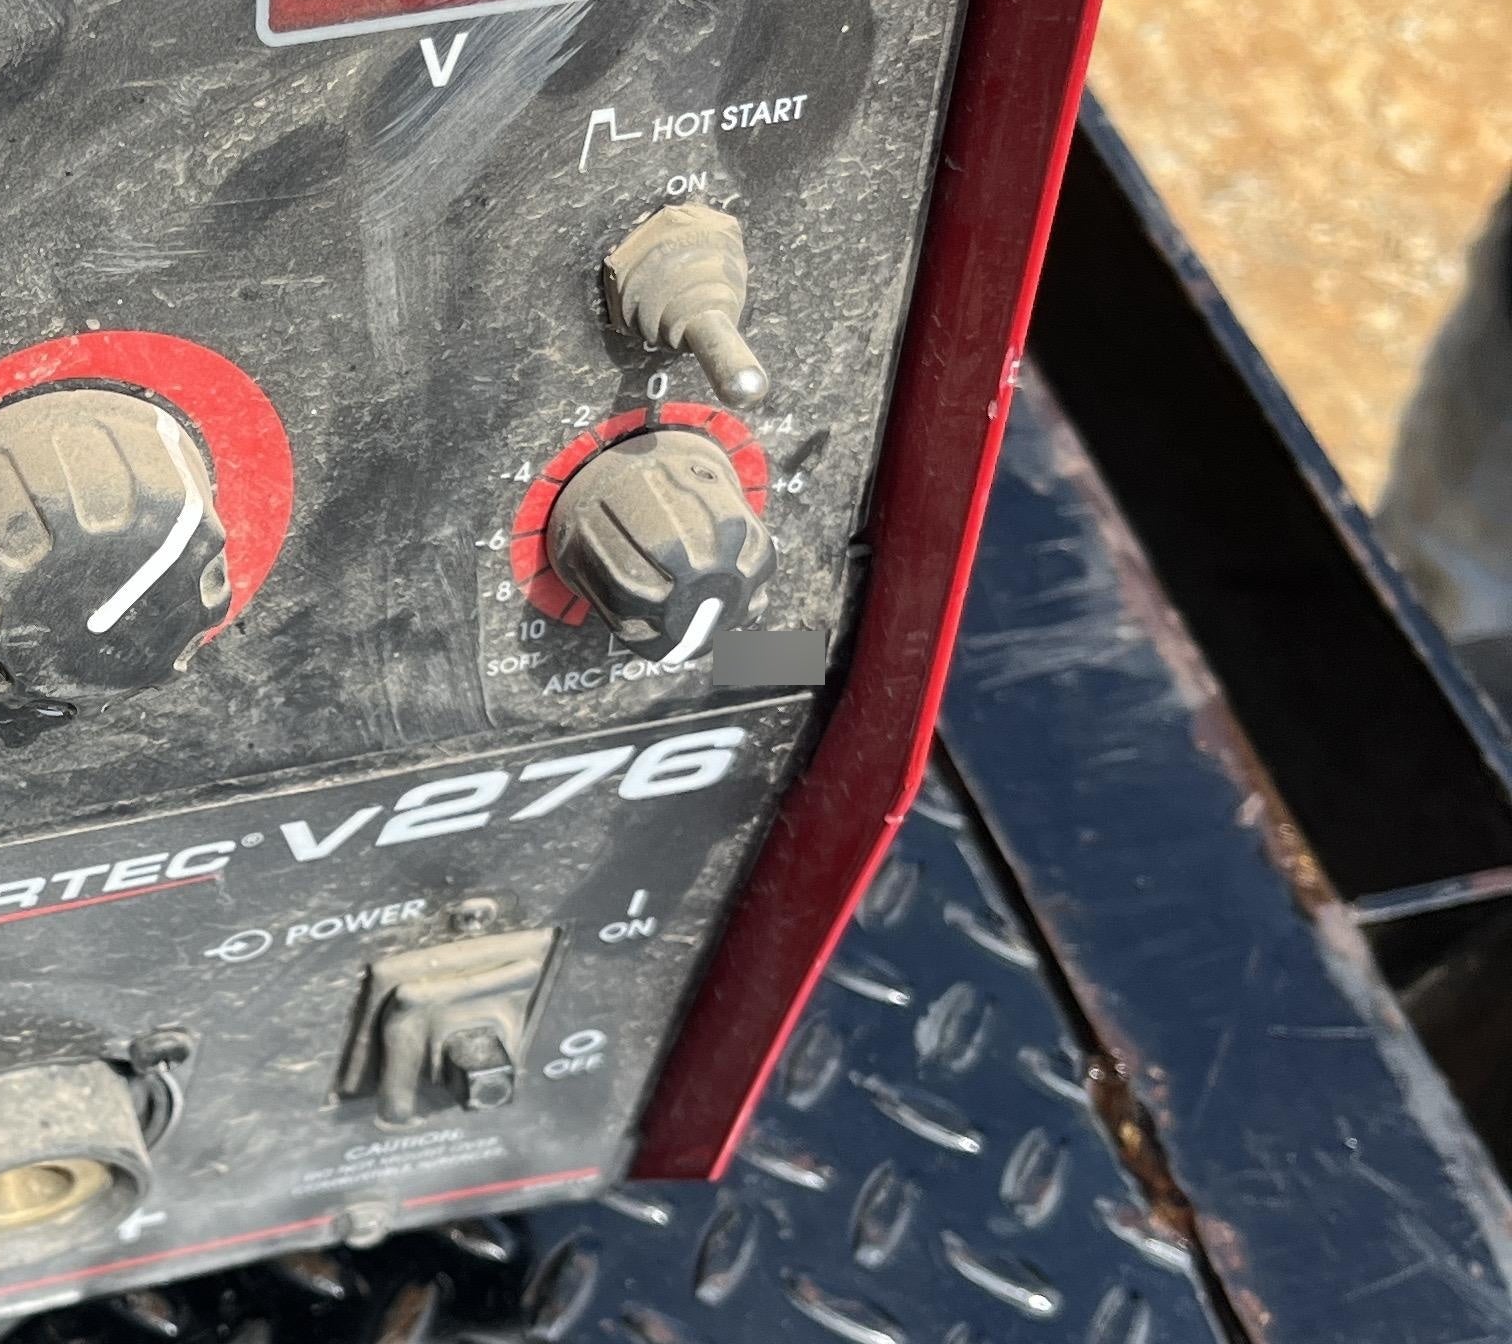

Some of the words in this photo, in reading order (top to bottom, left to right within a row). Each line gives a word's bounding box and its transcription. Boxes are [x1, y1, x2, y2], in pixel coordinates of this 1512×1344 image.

[419, 32, 470, 88] V
[652, 108, 716, 143] HOT
[720, 94, 808, 132] START
[666, 171, 708, 196] ON
[647, 373, 669, 400] 0
[561, 405, 591, 428] -2
[757, 413, 795, 435] +4
[499, 460, 532, 484] -4
[771, 470, 806, 495] +6
[475, 530, 506, 551] -6
[482, 581, 513, 602] -8
[541, 667, 606, 696] ARC
[280, 726, 746, 861] V276
[285, 897, 428, 945] POWER
[598, 917, 658, 944] ON
